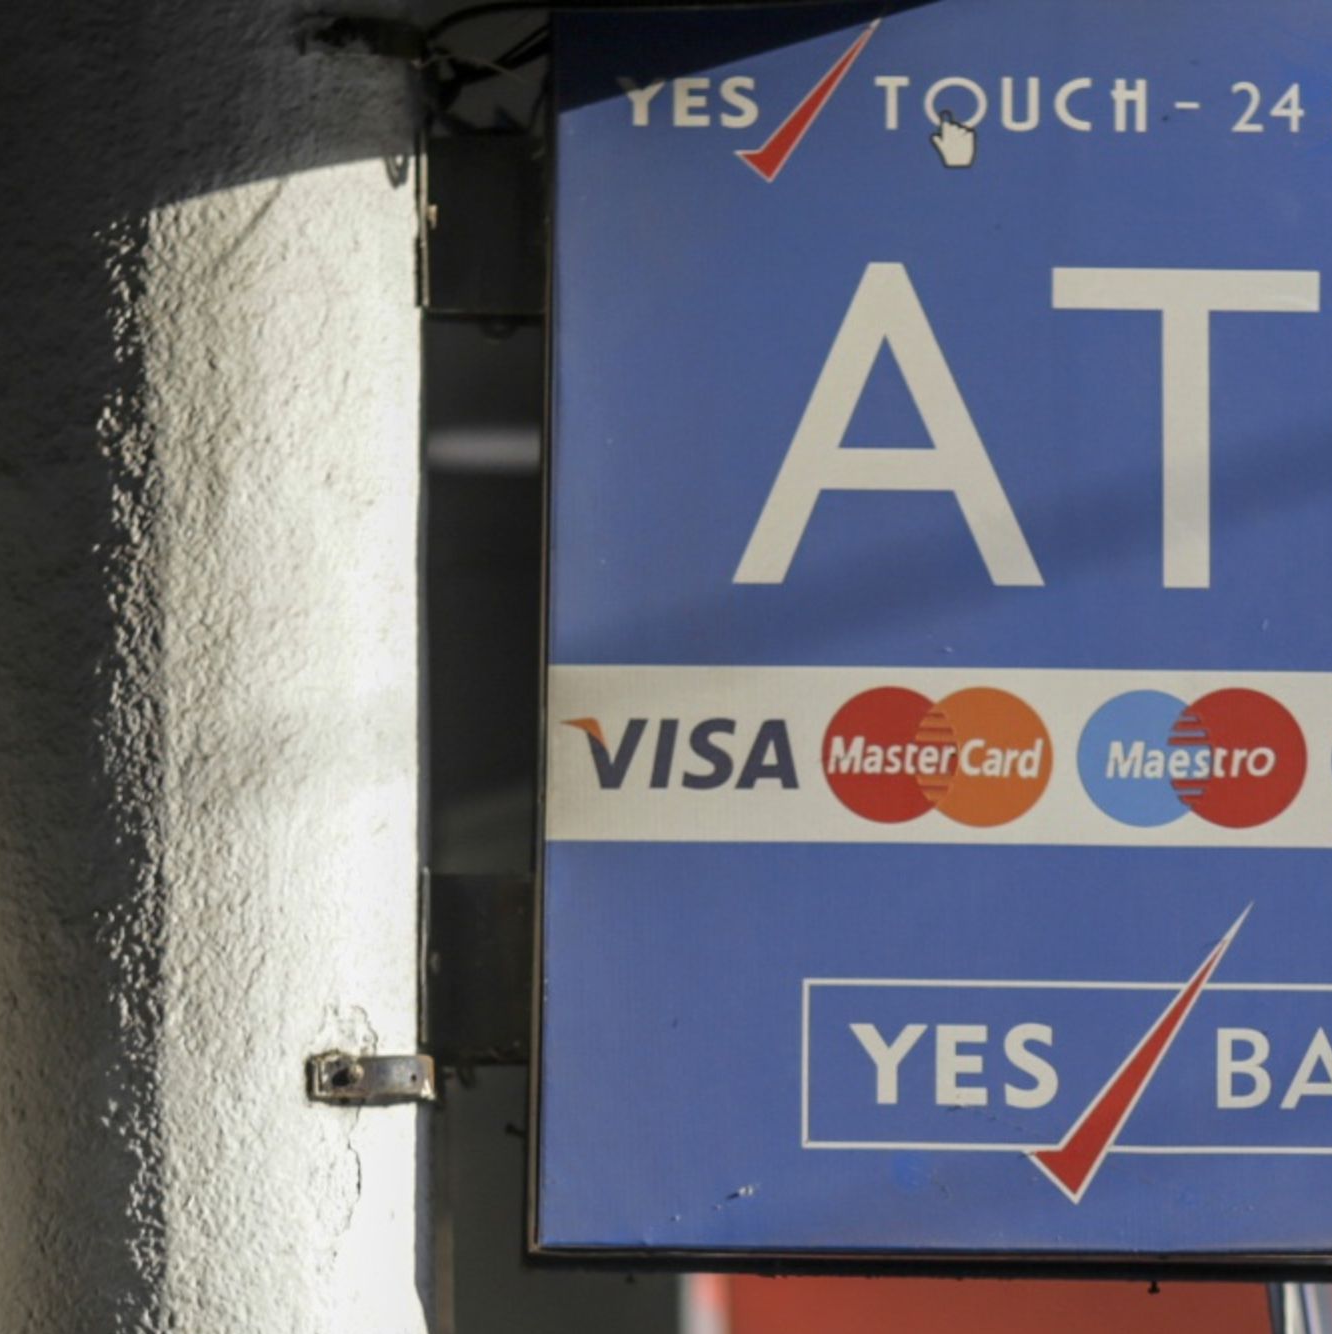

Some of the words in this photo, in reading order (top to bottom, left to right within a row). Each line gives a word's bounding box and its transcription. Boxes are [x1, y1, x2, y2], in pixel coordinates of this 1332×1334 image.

[616, 75, 760, 130] YES
[874, 75, 1148, 133] TOUCH
[1230, 81, 1305, 135] 24
[560, 716, 800, 790] VISA
[827, 735, 1044, 779] MasterCard
[1105, 739, 1277, 780] Maestro
[848, 1021, 1060, 1109] YES
